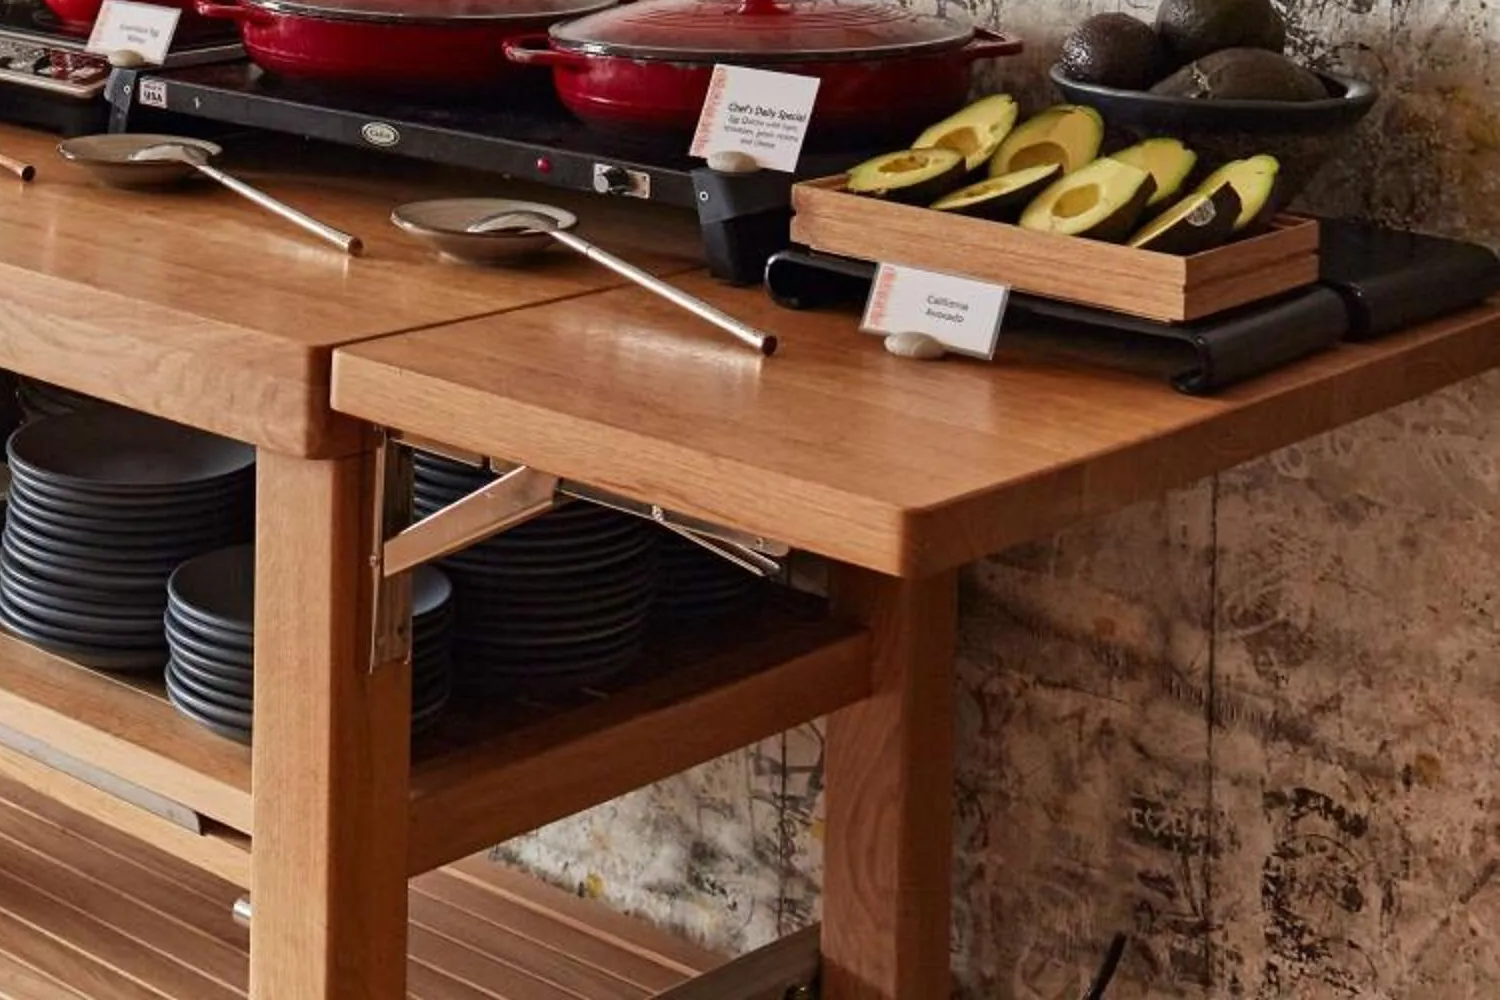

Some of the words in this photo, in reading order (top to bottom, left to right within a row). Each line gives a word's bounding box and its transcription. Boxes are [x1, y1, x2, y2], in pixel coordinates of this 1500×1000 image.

[143, 90, 163, 103] USA
[728, 102, 753, 114] Chef's
[754, 104, 777, 118] Daily
[777, 108, 807, 122] Special
[926, 295, 969, 312] California
[924, 307, 965, 323] Avocado
